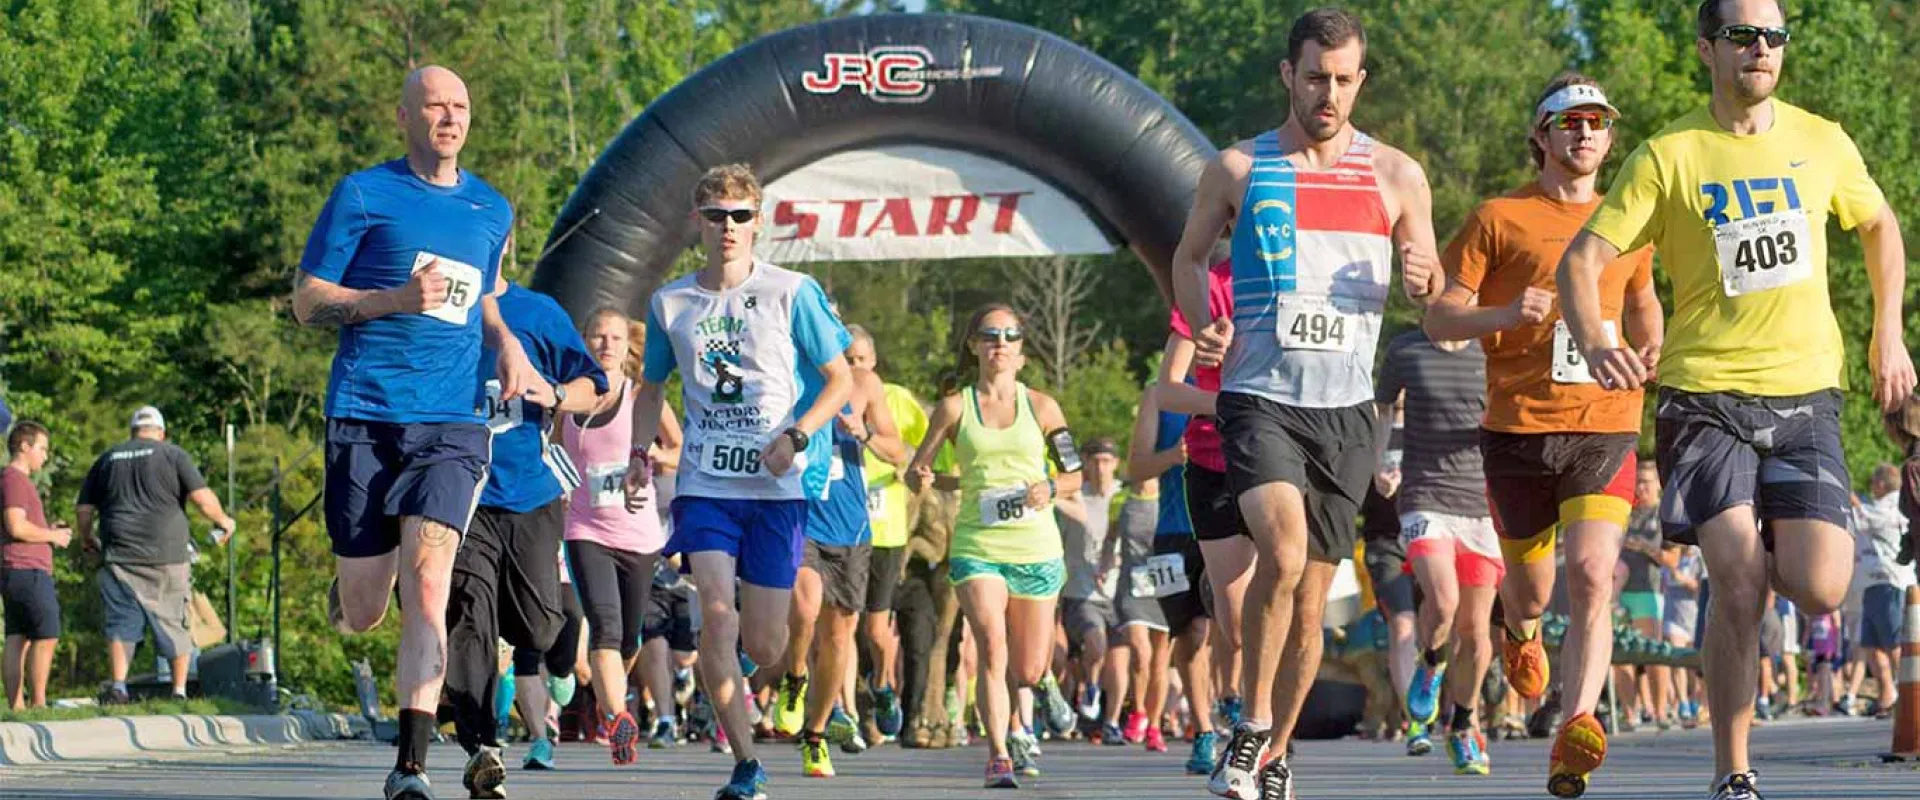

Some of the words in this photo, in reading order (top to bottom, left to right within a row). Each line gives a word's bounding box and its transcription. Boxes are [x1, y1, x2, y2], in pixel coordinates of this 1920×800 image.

[803, 49, 930, 98] JRC
[771, 191, 1035, 241] START
[1735, 231, 1797, 272] 403
[697, 316, 743, 336] TEAM
[1290, 313, 1345, 345] 494
[713, 444, 761, 474] 509
